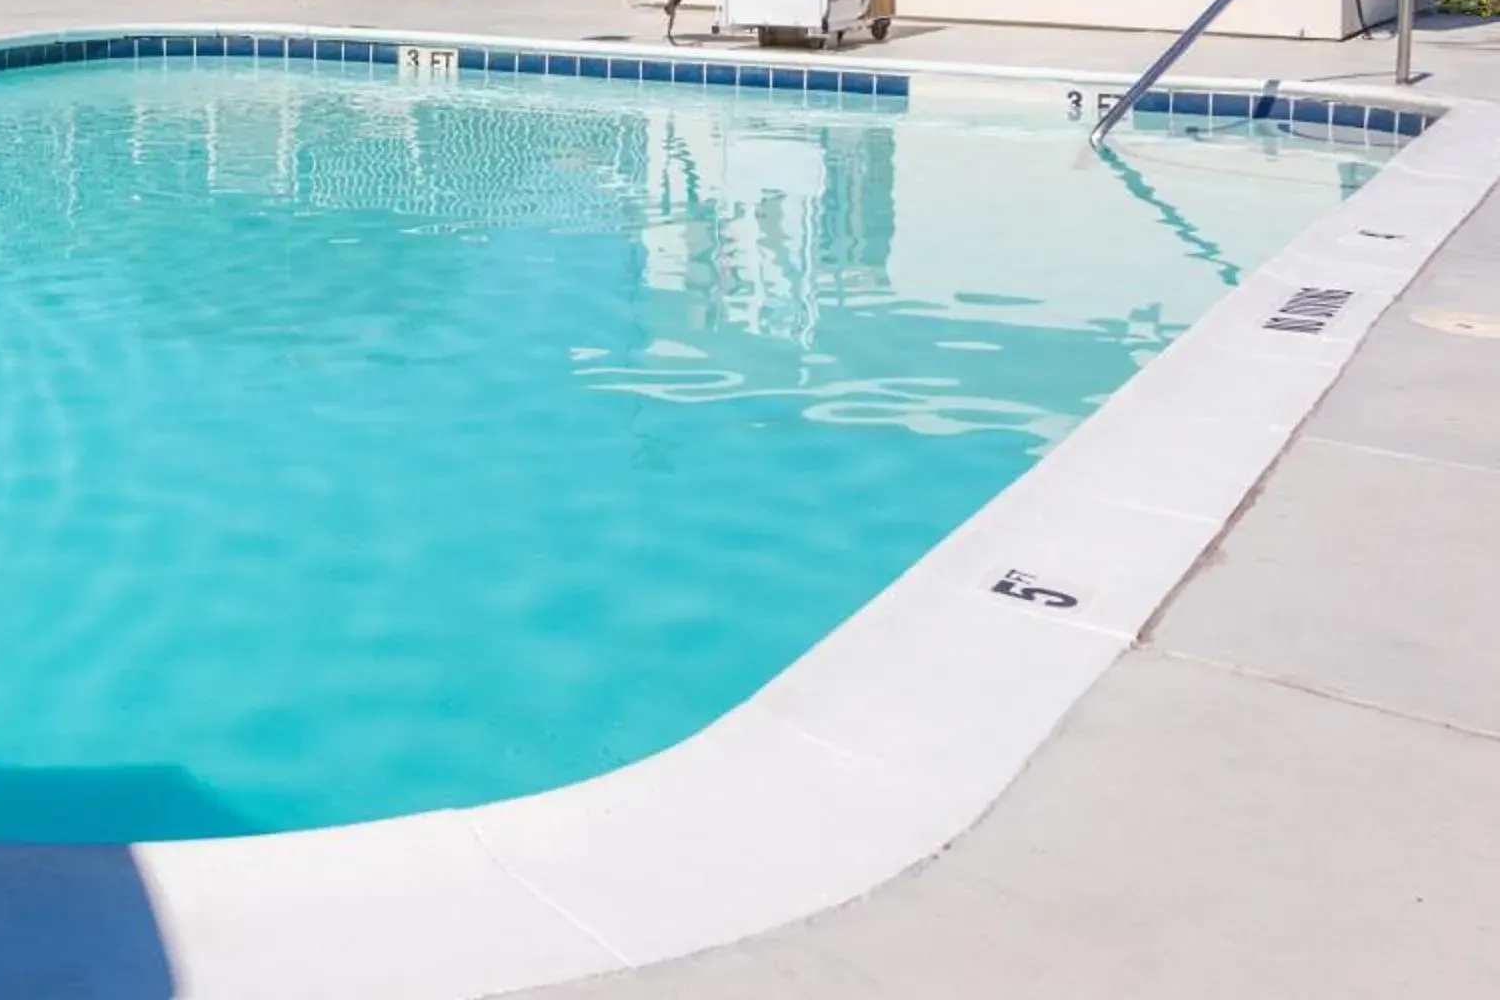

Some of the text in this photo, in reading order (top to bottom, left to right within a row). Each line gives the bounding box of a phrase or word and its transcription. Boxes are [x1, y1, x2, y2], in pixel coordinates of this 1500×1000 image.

[407, 48, 454, 68] 3 FT
[1066, 90, 1083, 109] 3
[991, 579, 1078, 608] 5
